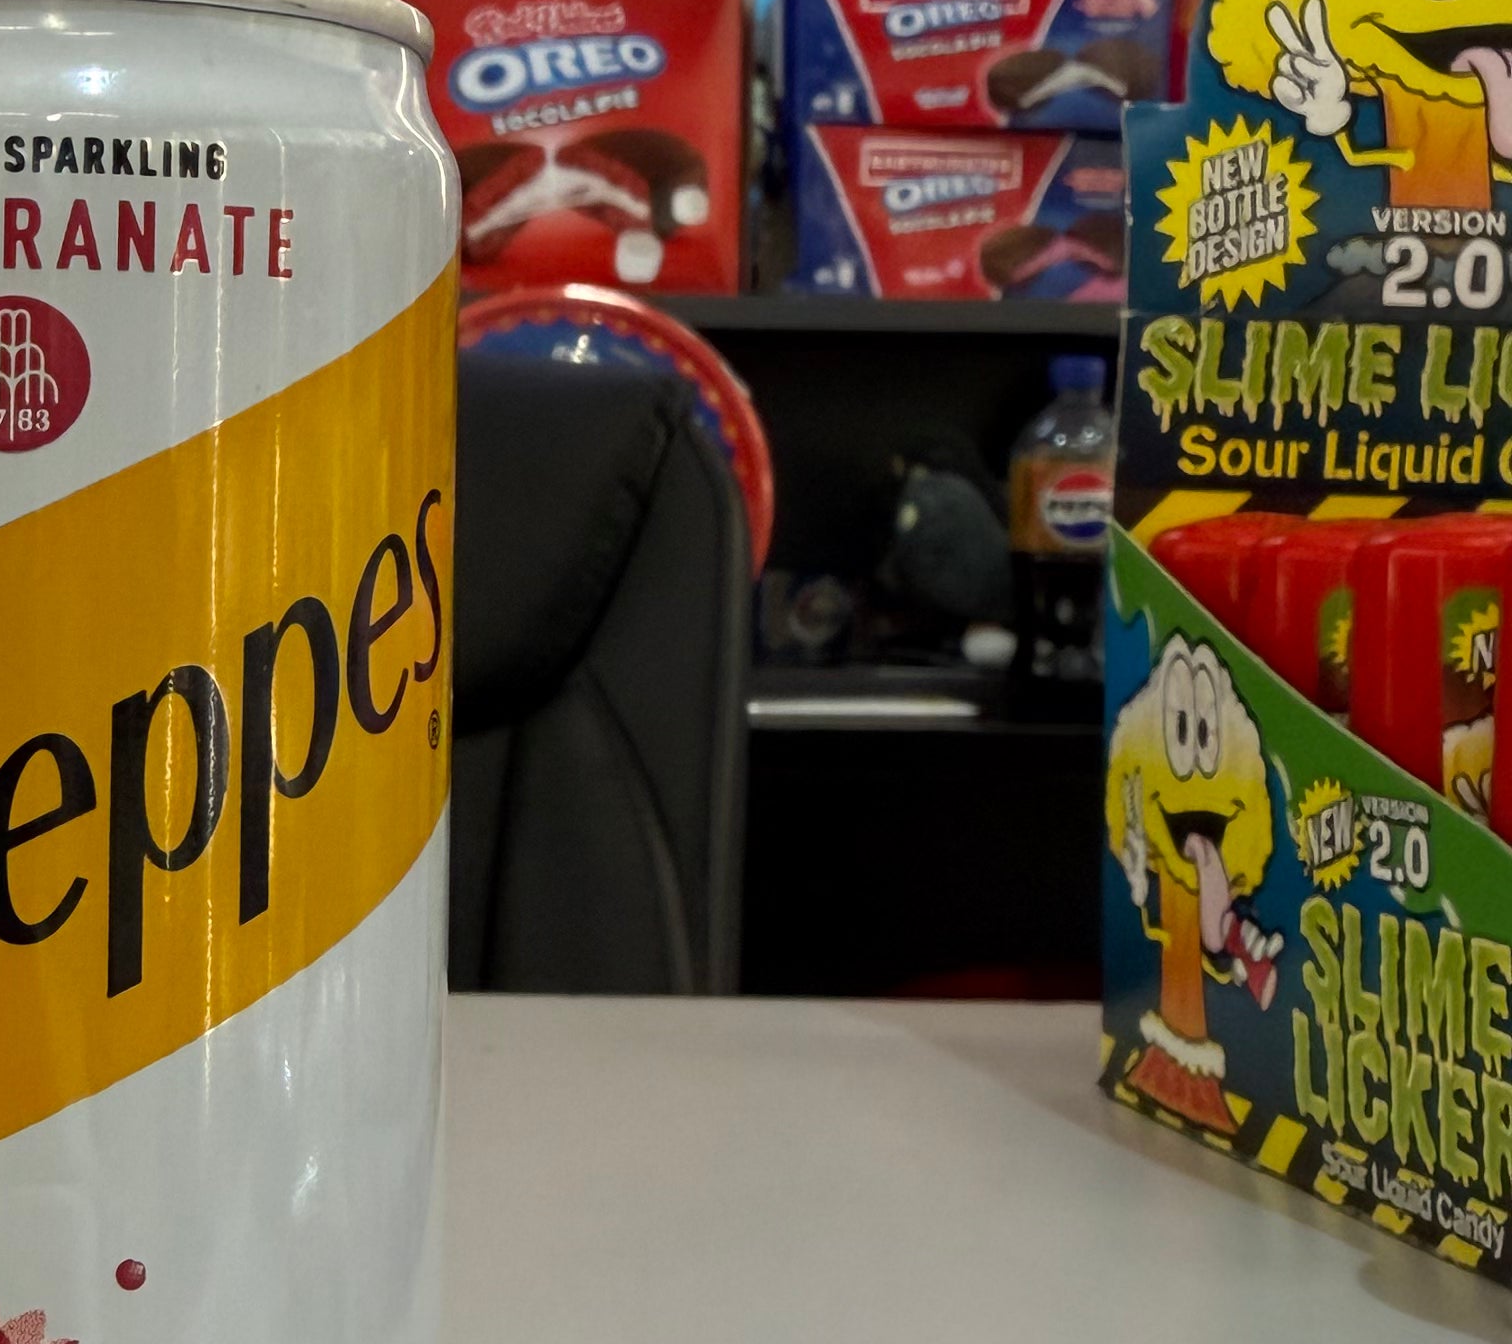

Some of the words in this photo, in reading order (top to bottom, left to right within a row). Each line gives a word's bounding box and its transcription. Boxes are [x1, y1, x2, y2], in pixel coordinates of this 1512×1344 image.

[454, 34, 662, 105] OREO
[3, 135, 228, 182] SPARKLING
[1202, 140, 1267, 197] NEW
[1189, 172, 1288, 240] BOTTLE
[1371, 205, 1508, 237] VERSION
[1187, 214, 1287, 282] DESIGN
[1382, 234, 1504, 310] 2.0
[1137, 313, 1402, 434] SLIME
[1177, 424, 1310, 478] Sour
[1323, 430, 1484, 491] Liquid
[1368, 819, 1430, 889] 2.0
[1299, 894, 1512, 1078] SLIME
[1436, 1191, 1505, 1259] Candy
